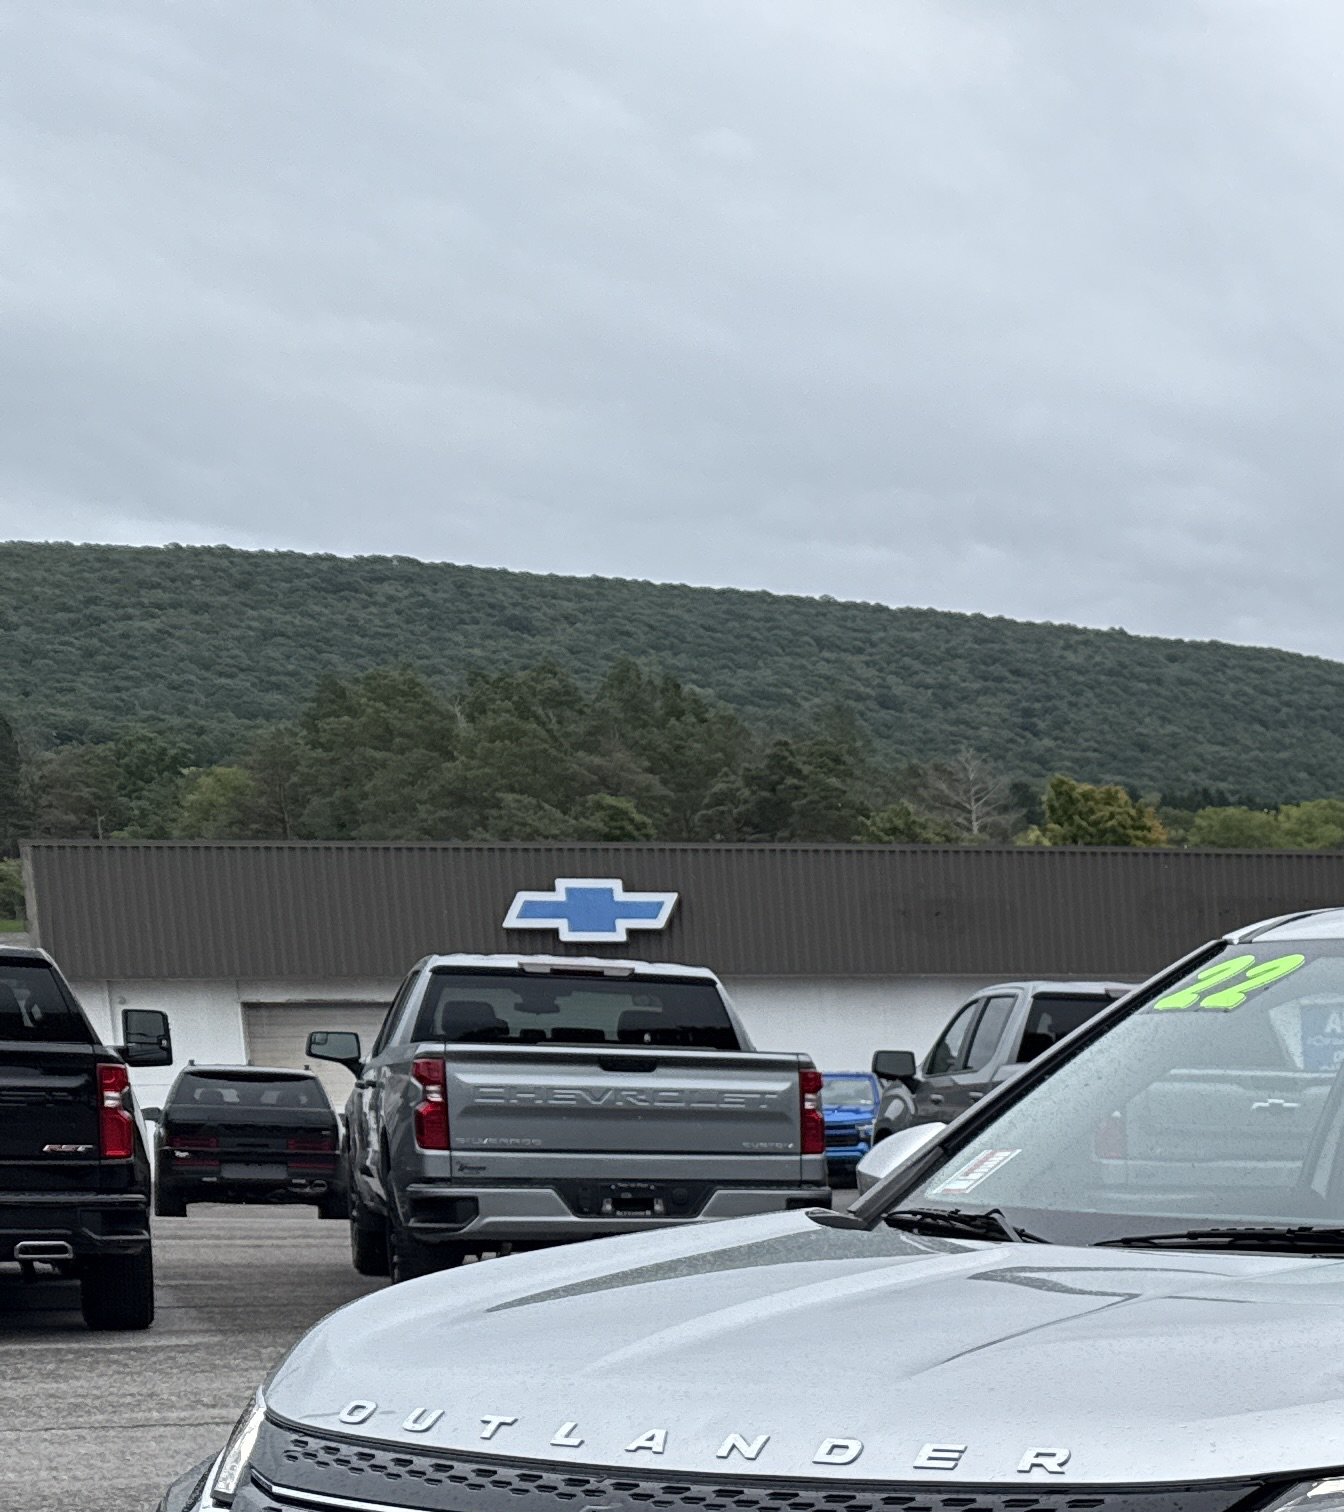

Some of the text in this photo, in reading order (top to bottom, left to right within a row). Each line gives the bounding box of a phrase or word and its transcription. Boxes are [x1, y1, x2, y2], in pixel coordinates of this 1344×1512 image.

[1154, 953, 1306, 1010] 22
[474, 1086, 779, 1108] CHEVROLET
[337, 1399, 1073, 1476] OUTLANDER
